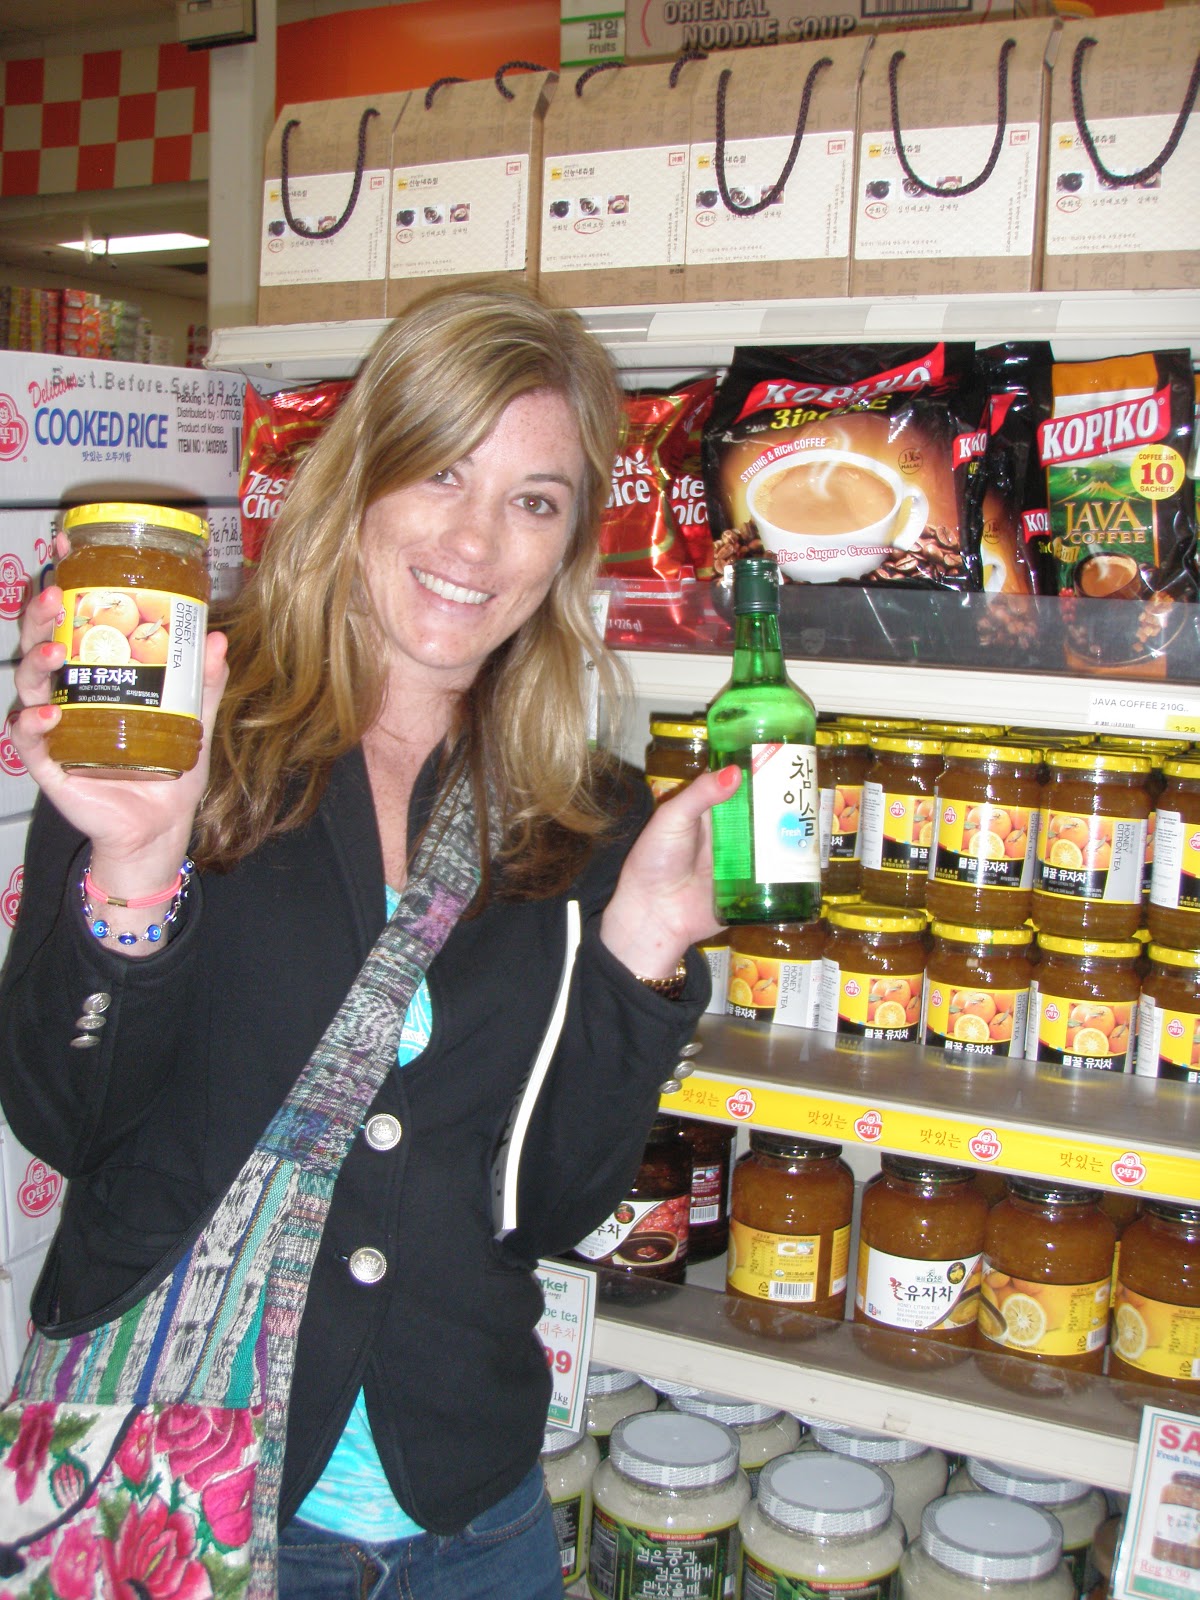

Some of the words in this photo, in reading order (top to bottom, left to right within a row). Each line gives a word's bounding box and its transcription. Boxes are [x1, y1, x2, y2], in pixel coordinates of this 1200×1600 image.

[664, 0, 770, 24] ORIENTAL
[588, 21, 619, 40] 과일
[682, 19, 779, 50] NOODLE
[787, 16, 857, 42] SOUP
[589, 43, 616, 54] Fruits
[757, 365, 931, 408] KOPIKO
[177, 407, 208, 419] Distributed
[209, 409, 215, 420] by
[0, 427, 20, 445] 뚜기
[34, 407, 124, 448] COOKED
[127, 412, 169, 449] RICE
[177, 422, 200, 434] Product
[207, 425, 224, 434] Korea
[1042, 397, 1159, 460] KOPIKO
[740, 455, 768, 483] STRONG
[773, 443, 793, 458] RICH
[794, 437, 827, 451] COFFEE
[1140, 462, 1174, 486] 10
[1139, 485, 1175, 493] SACHETS
[1063, 501, 1147, 540] JAVA
[1070, 531, 1146, 545] COFFEE
[806, 547, 839, 562] Sugar
[847, 545, 894, 557] Creamer
[174, 602, 186, 645] CITRON
[183, 604, 193, 645] HONEY
[173, 648, 183, 669] TEA
[78, 668, 92, 684] 꿀
[93, 668, 138, 686] 유자차
[1092, 698, 1117, 707] JAVA
[1120, 700, 1157, 710] COFFEE
[755, 745, 776, 768] IMPORTED
[783, 755, 817, 837] 참이슬
[781, 827, 801, 837] Fresh
[1113, 823, 1125, 856] CITRON
[1121, 824, 1131, 852] HONEY
[1113, 857, 1121, 872] TEA
[1058, 869, 1087, 884] 유자차
[781, 965, 791, 993] CITRON
[789, 965, 798, 992] HONEY
[780, 995, 789, 1009] TEA
[735, 1005, 757, 1020] 유자차
[885, 1029, 909, 1041] 유자차
[964, 1042, 994, 1056] 유자차
[1083, 1057, 1112, 1070] 유자차
[682, 1088, 720, 1108] 맛있는
[730, 1102, 751, 1113] 오뚜기
[807, 1110, 848, 1130] 맛있는
[859, 1125, 881, 1136] 오뚜기
[920, 1128, 962, 1149] 맛있는
[974, 1143, 996, 1154] 오뚜기
[1060, 1152, 1104, 1173] 맛있는
[1117, 1167, 1140, 1180] 오뚜기
[26, 1179, 55, 1207] 오뚜기
[904, 1285, 953, 1302] 유자차
[560, 1311, 578, 1324] tea
[538, 1322, 577, 1342] 대추차
[1156, 1449, 1181, 1464] Fresh
